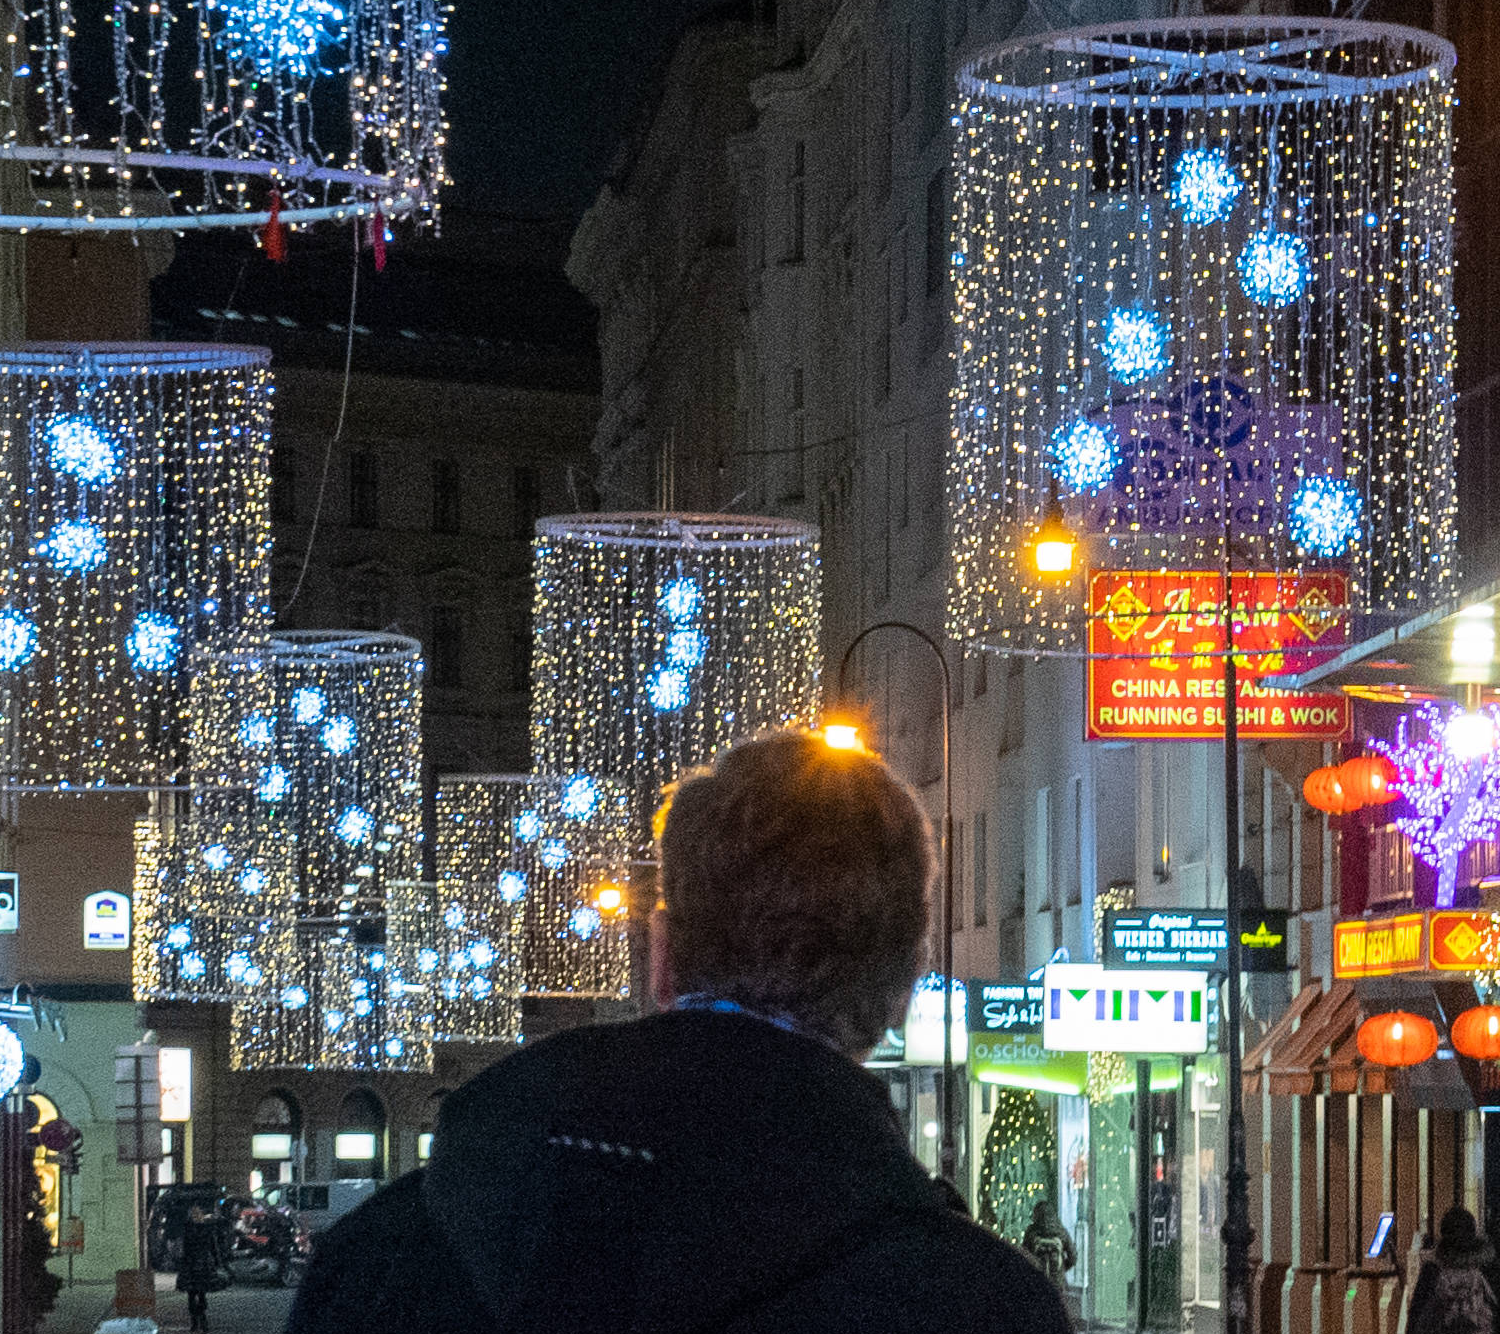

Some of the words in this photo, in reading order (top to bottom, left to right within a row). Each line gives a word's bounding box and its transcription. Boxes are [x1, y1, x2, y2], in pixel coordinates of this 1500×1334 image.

[1144, 586, 1281, 640] ASIAM
[1111, 679, 1181, 698] CHINA
[1099, 707, 1197, 725] RUNNING
[1203, 707, 1266, 726] SUSHI
[1270, 708, 1286, 726] &
[1290, 708, 1339, 725] WOK
[1112, 930, 1166, 949] WIENER
[1169, 930, 1228, 950] BIERBAR
[1338, 931, 1367, 968] CHINA
[1366, 924, 1422, 966] RESTAURANT
